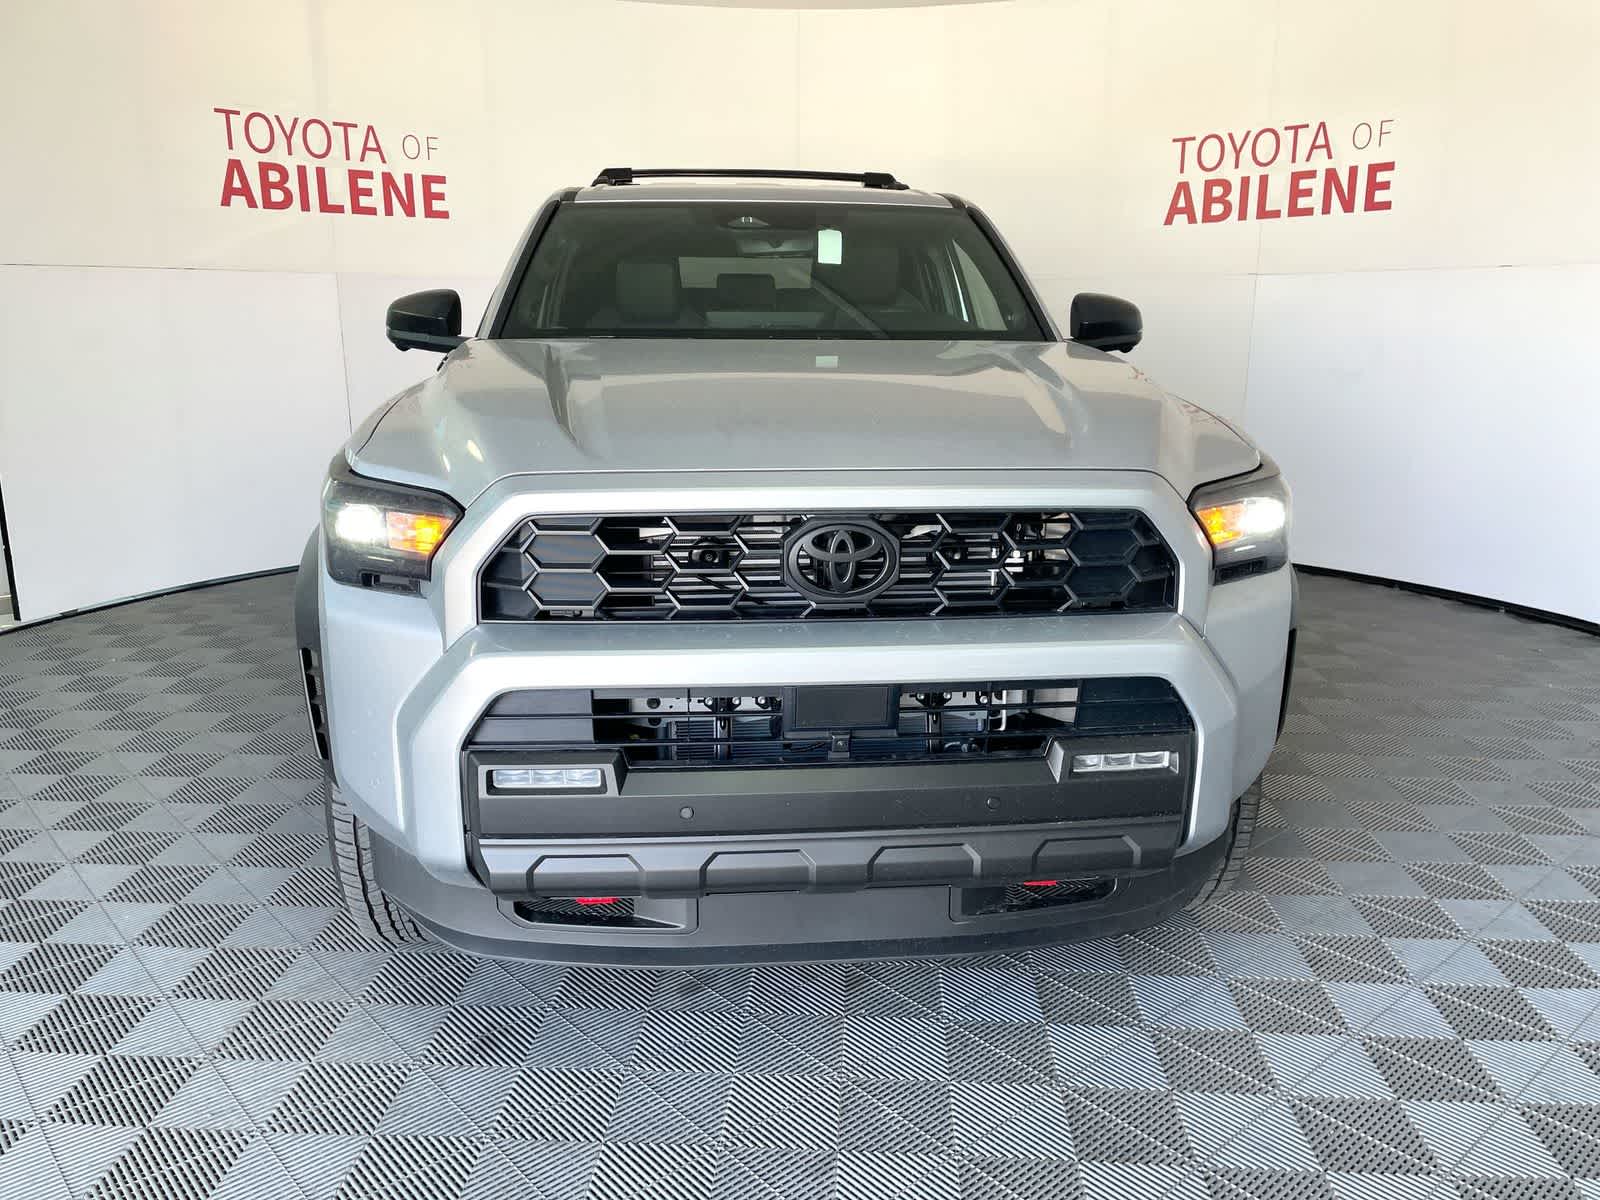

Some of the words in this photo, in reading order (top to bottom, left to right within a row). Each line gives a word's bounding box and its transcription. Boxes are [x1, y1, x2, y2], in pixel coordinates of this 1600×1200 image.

[213, 107, 388, 164] TOYOTA
[402, 134, 439, 160] OF
[1171, 121, 1334, 174] TOYOTA
[1352, 119, 1395, 149] OF
[220, 158, 450, 219] ABILENE
[1163, 161, 1396, 226] ABILENE
